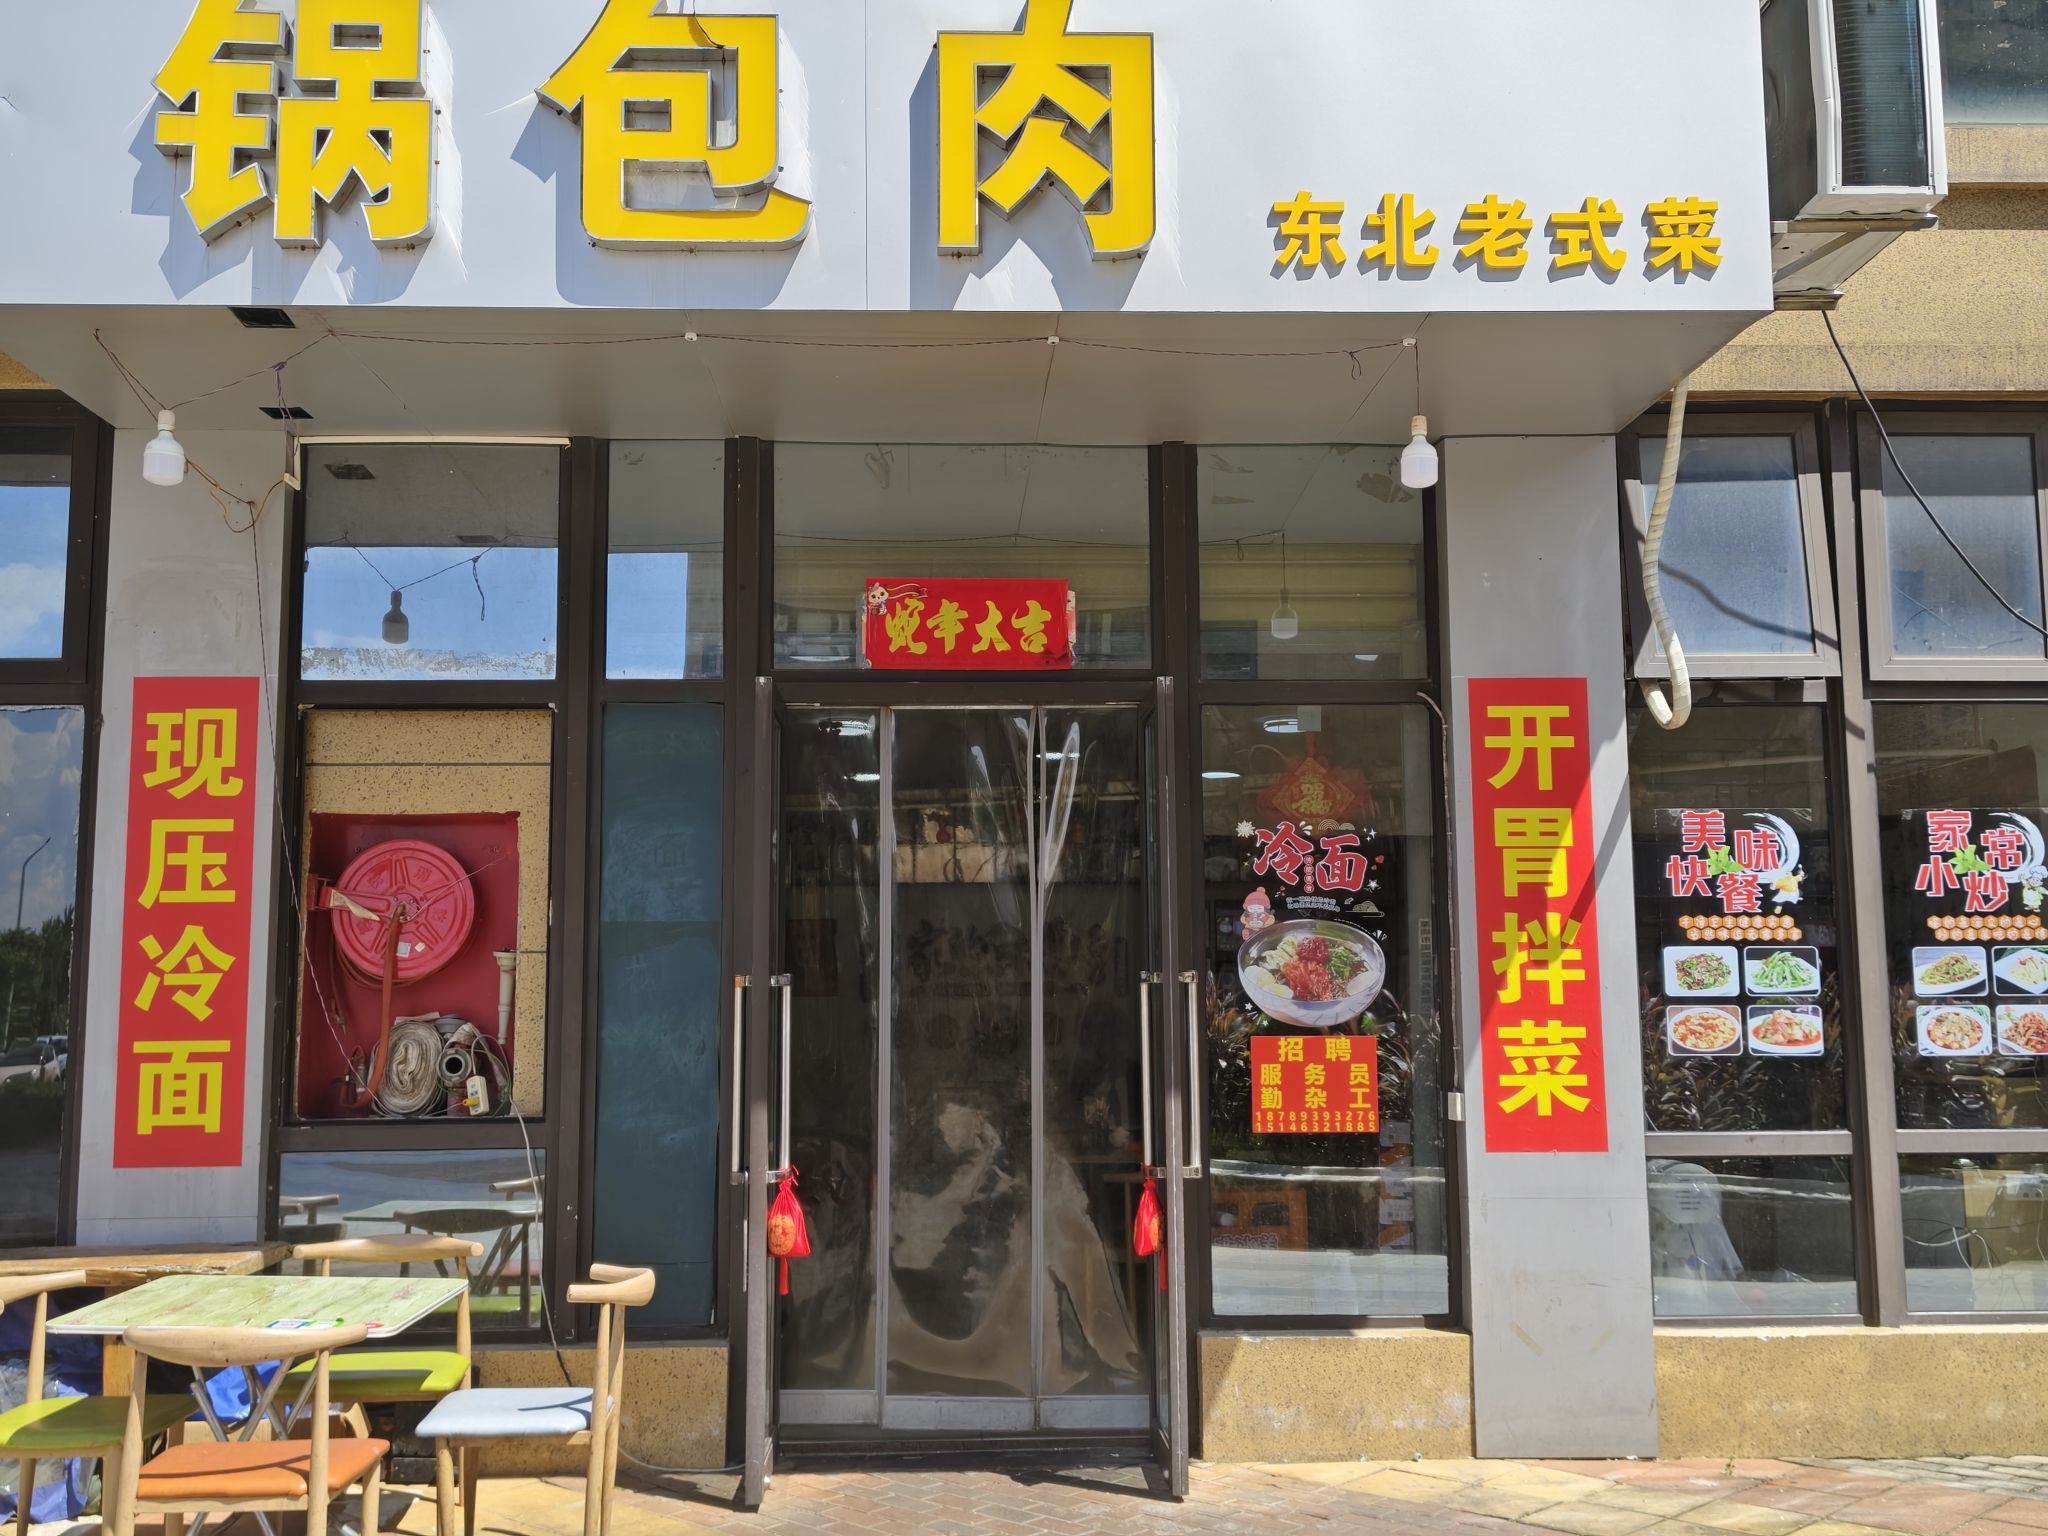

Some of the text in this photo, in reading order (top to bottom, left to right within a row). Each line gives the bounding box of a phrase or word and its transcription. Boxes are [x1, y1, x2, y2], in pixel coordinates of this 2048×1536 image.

[152, 0, 1157, 260] 锅包肉
[1272, 190, 1725, 273] 东北老式菜
[884, 598, 1053, 655] 蛇年大吉
[1252, 820, 1368, 892] 冷面
[1680, 809, 1781, 872] 美味
[1926, 809, 2025, 871] 家常
[1483, 705, 1591, 1117] 开胃拌菜
[1665, 854, 1764, 914] 快餐
[1914, 854, 2010, 913] 小炒
[132, 707, 244, 1136] 现压冷面
[1260, 1063, 1371, 1086] 服务员
[1277, 1036, 1352, 1062] 招聘
[1255, 1111, 1376, 1121] 18789393276
[1255, 1122, 1376, 1132] 15146321885
[1260, 1087, 1372, 1110] 勤杂工
